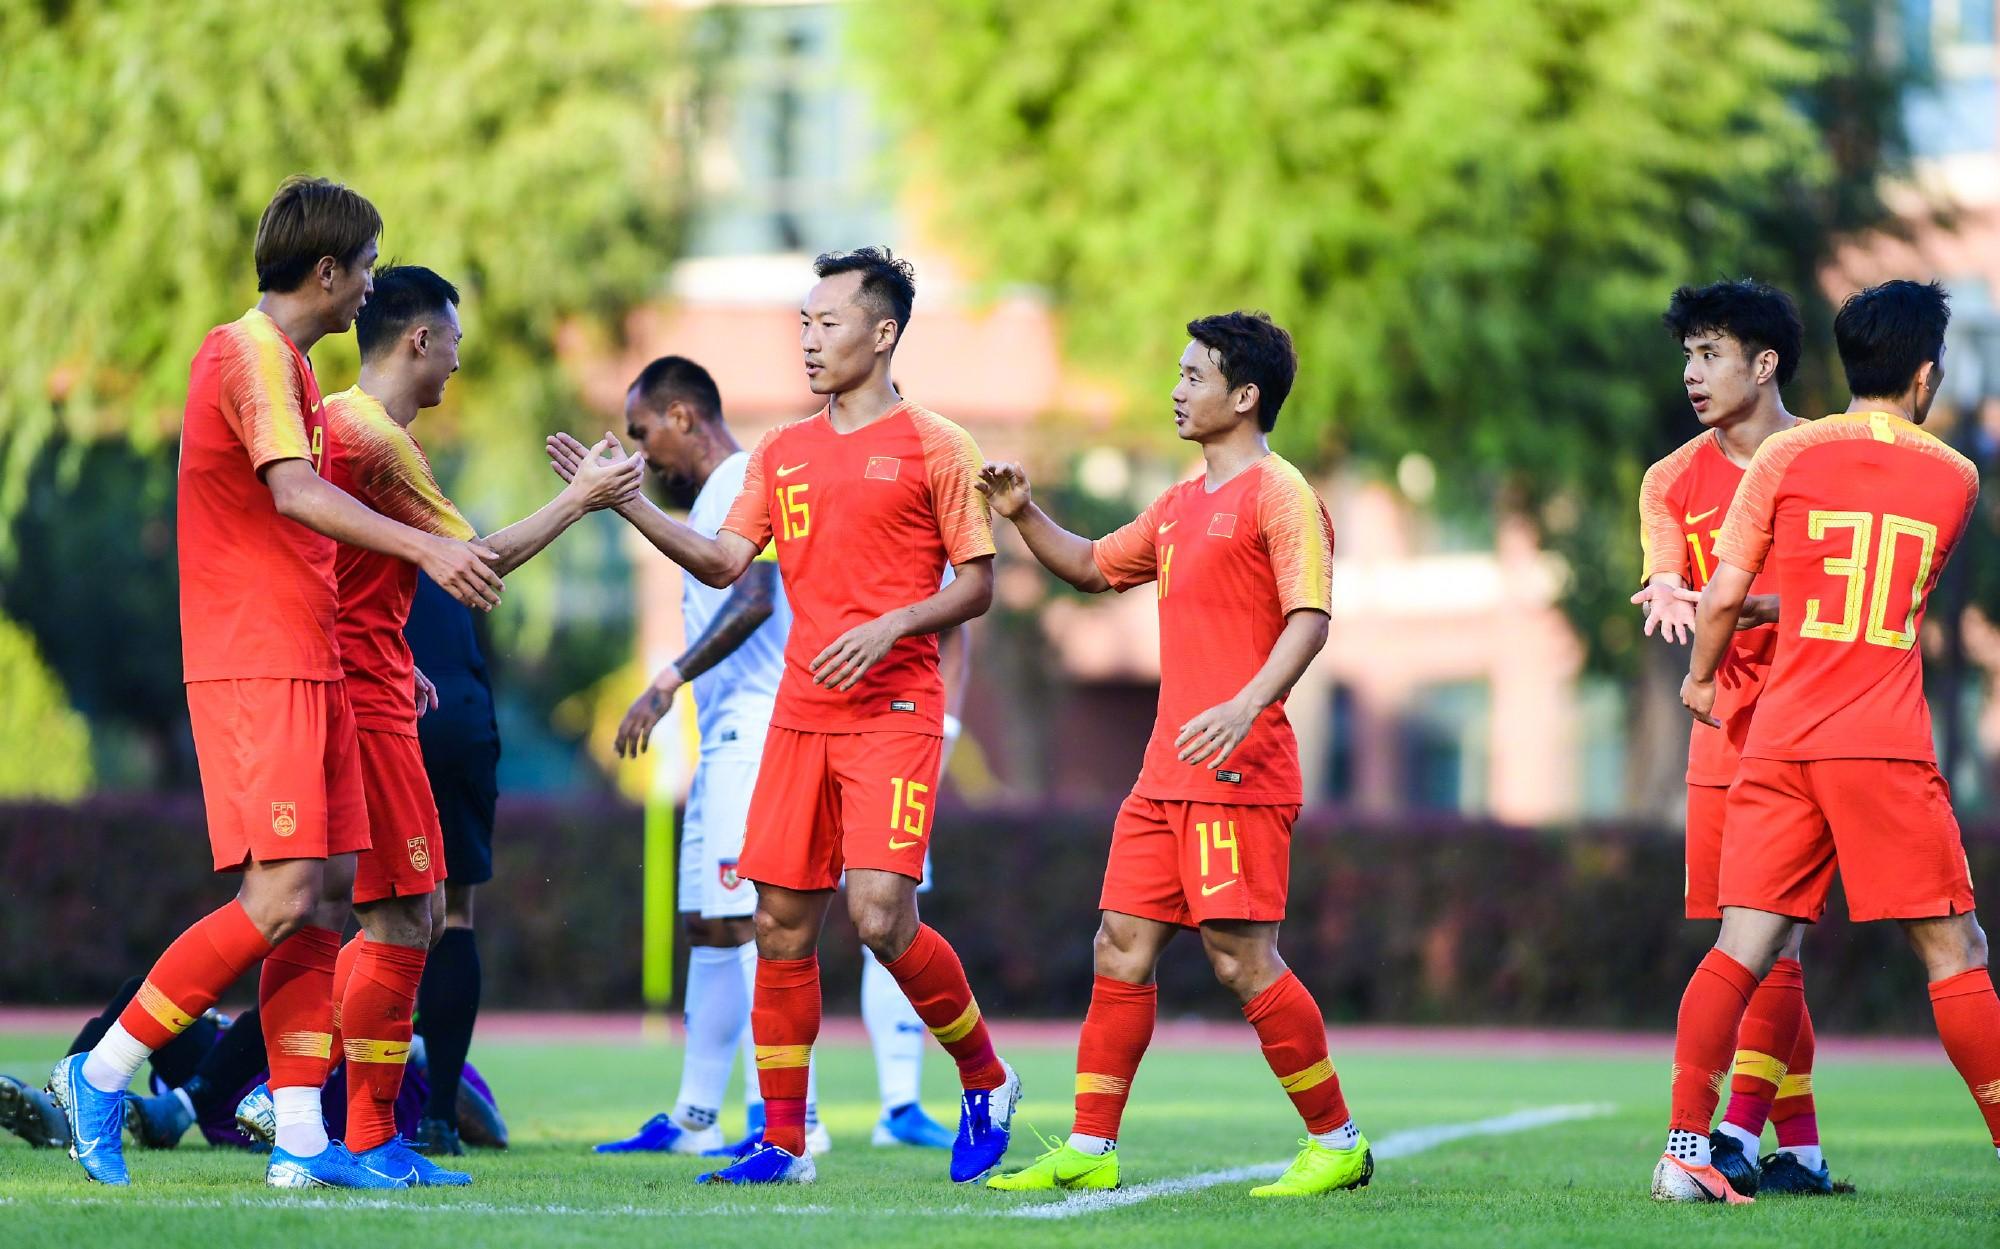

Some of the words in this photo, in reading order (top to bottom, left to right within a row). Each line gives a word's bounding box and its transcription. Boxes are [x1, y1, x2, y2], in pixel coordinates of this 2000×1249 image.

[776, 483, 810, 541] 15
[1800, 510, 1938, 650] 30
[890, 777, 929, 837] 15
[1195, 820, 1240, 877] 14
